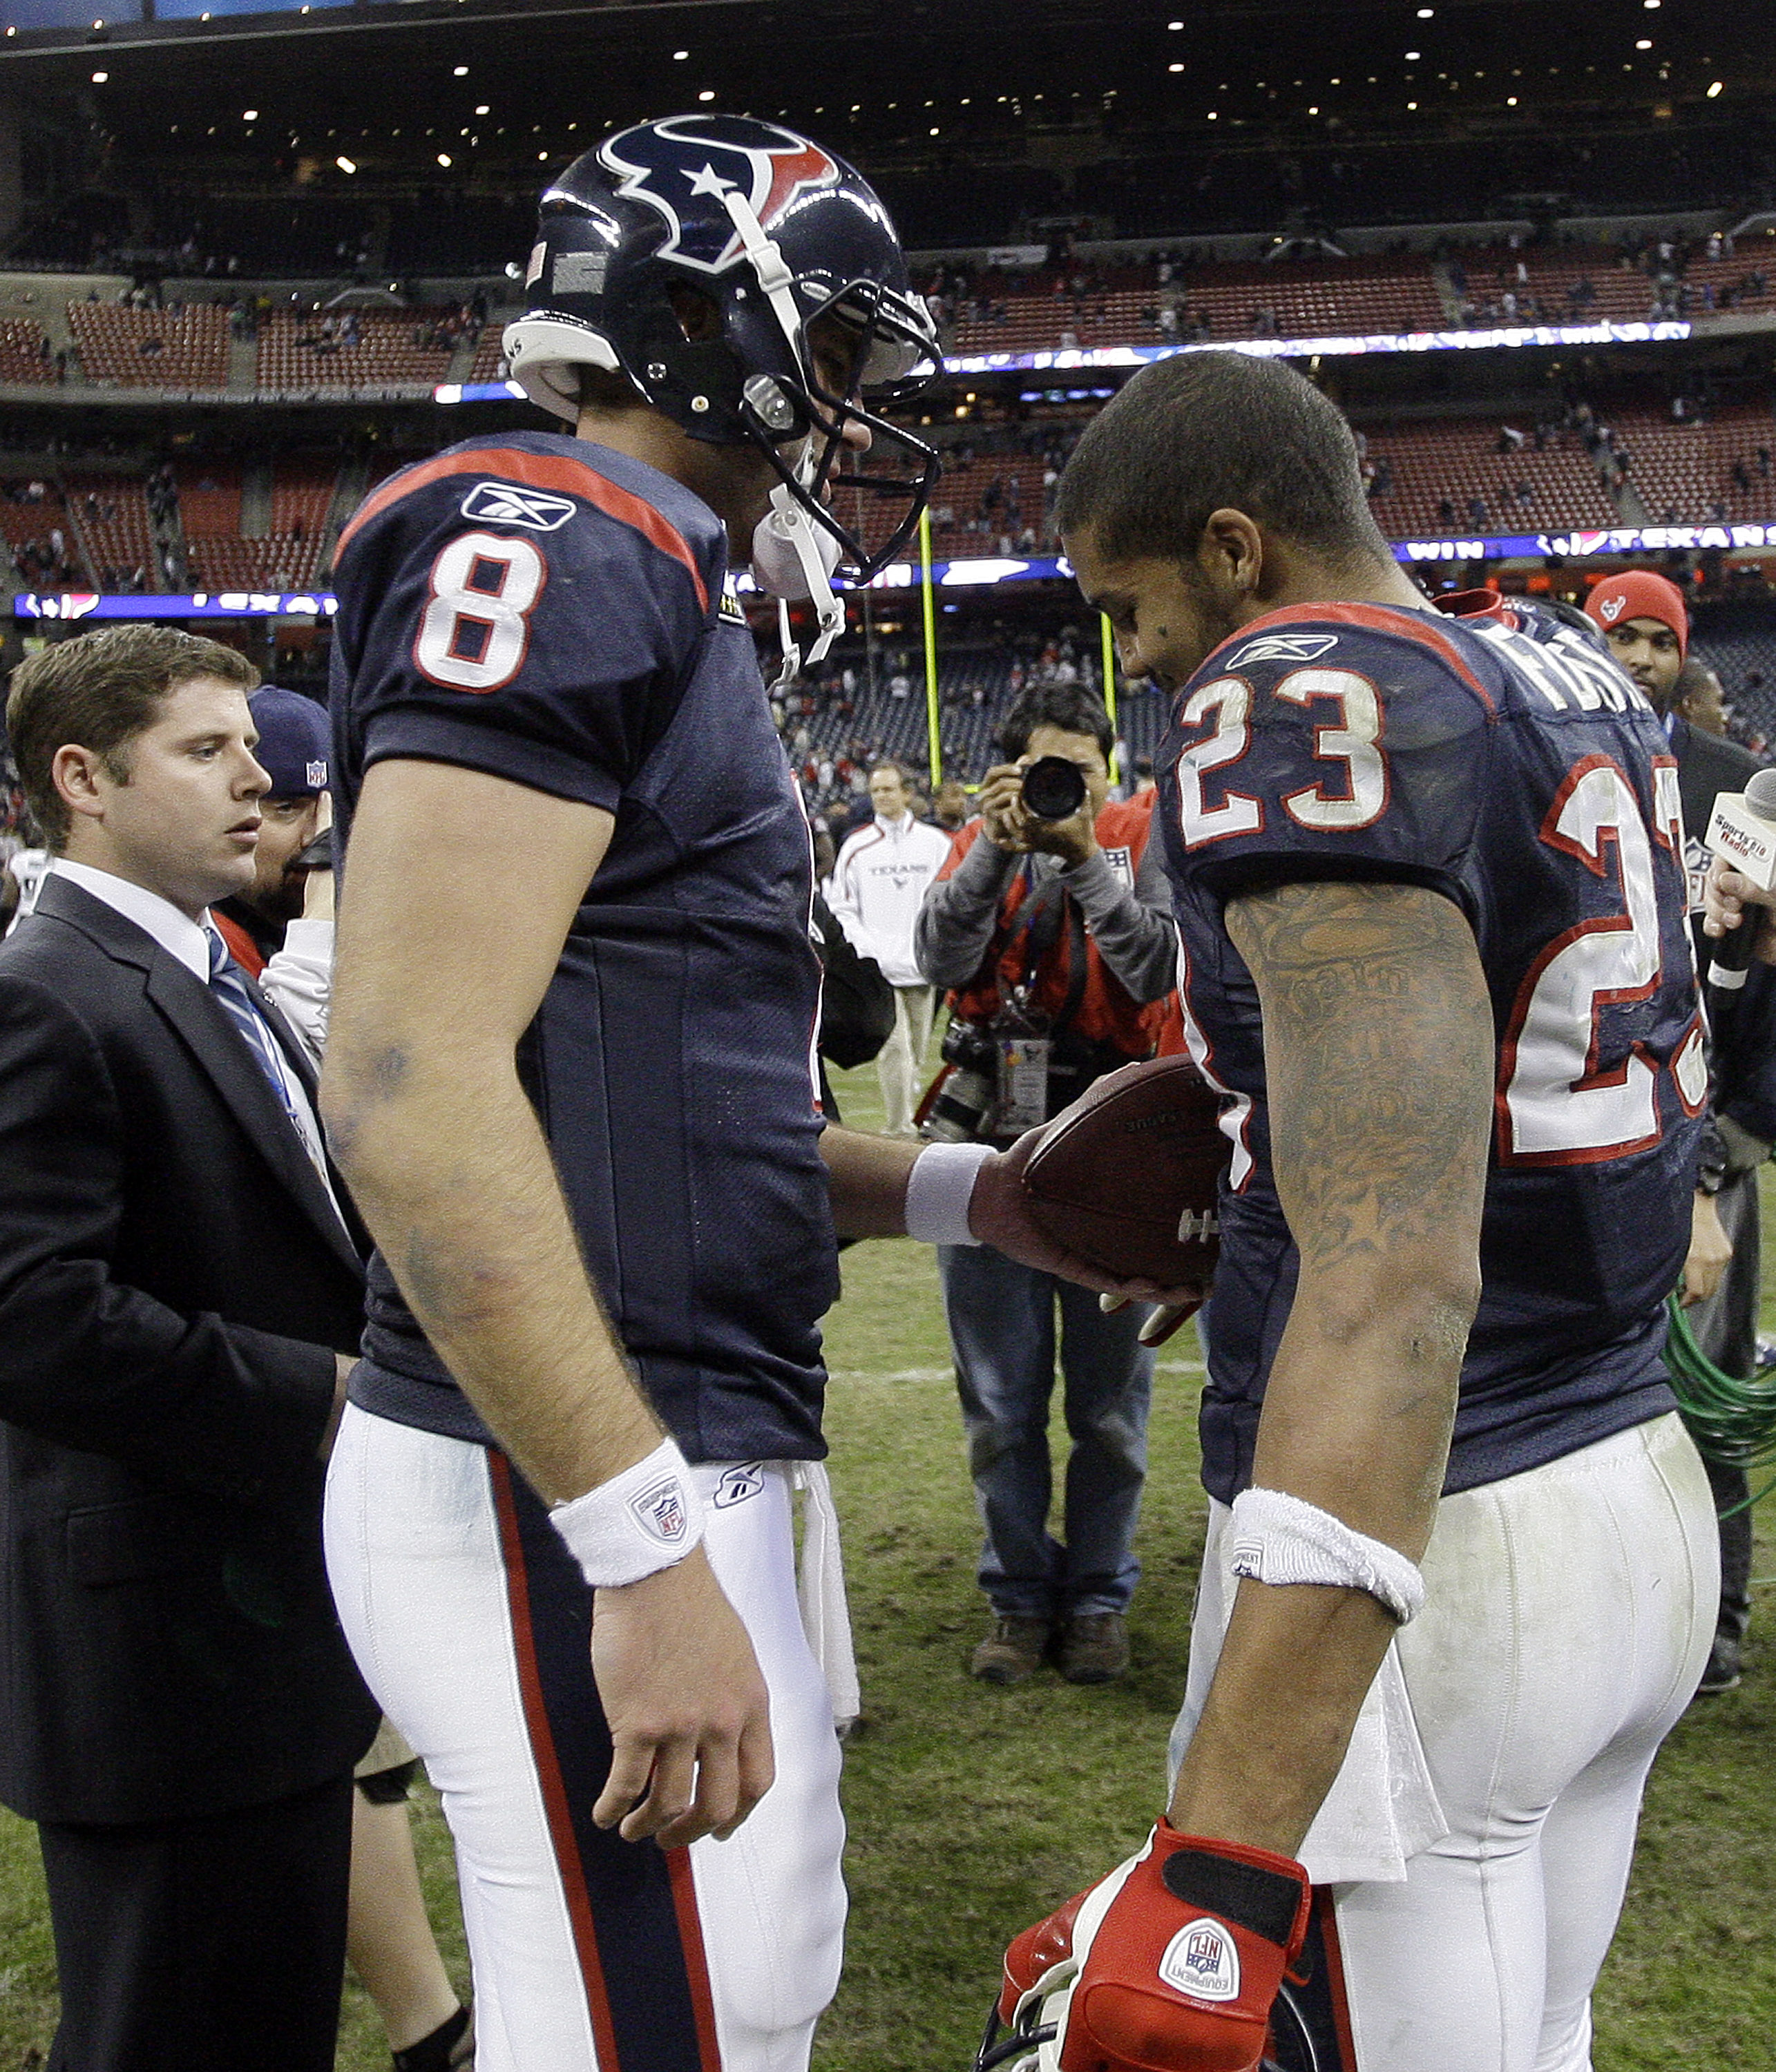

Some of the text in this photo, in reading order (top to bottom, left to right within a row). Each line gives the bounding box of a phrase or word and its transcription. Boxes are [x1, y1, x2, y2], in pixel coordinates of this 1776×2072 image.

[1406, 541, 1485, 561] WIN
[412, 529, 549, 694] 8
[1174, 666, 1391, 854] 23
[1715, 814, 1749, 845] Sports
[1721, 831, 1748, 857] Radio
[660, 1511, 684, 1533] NFL
[1193, 1934, 1220, 1959] NFL
[1170, 1964, 1230, 1991] EQUIPMENT
